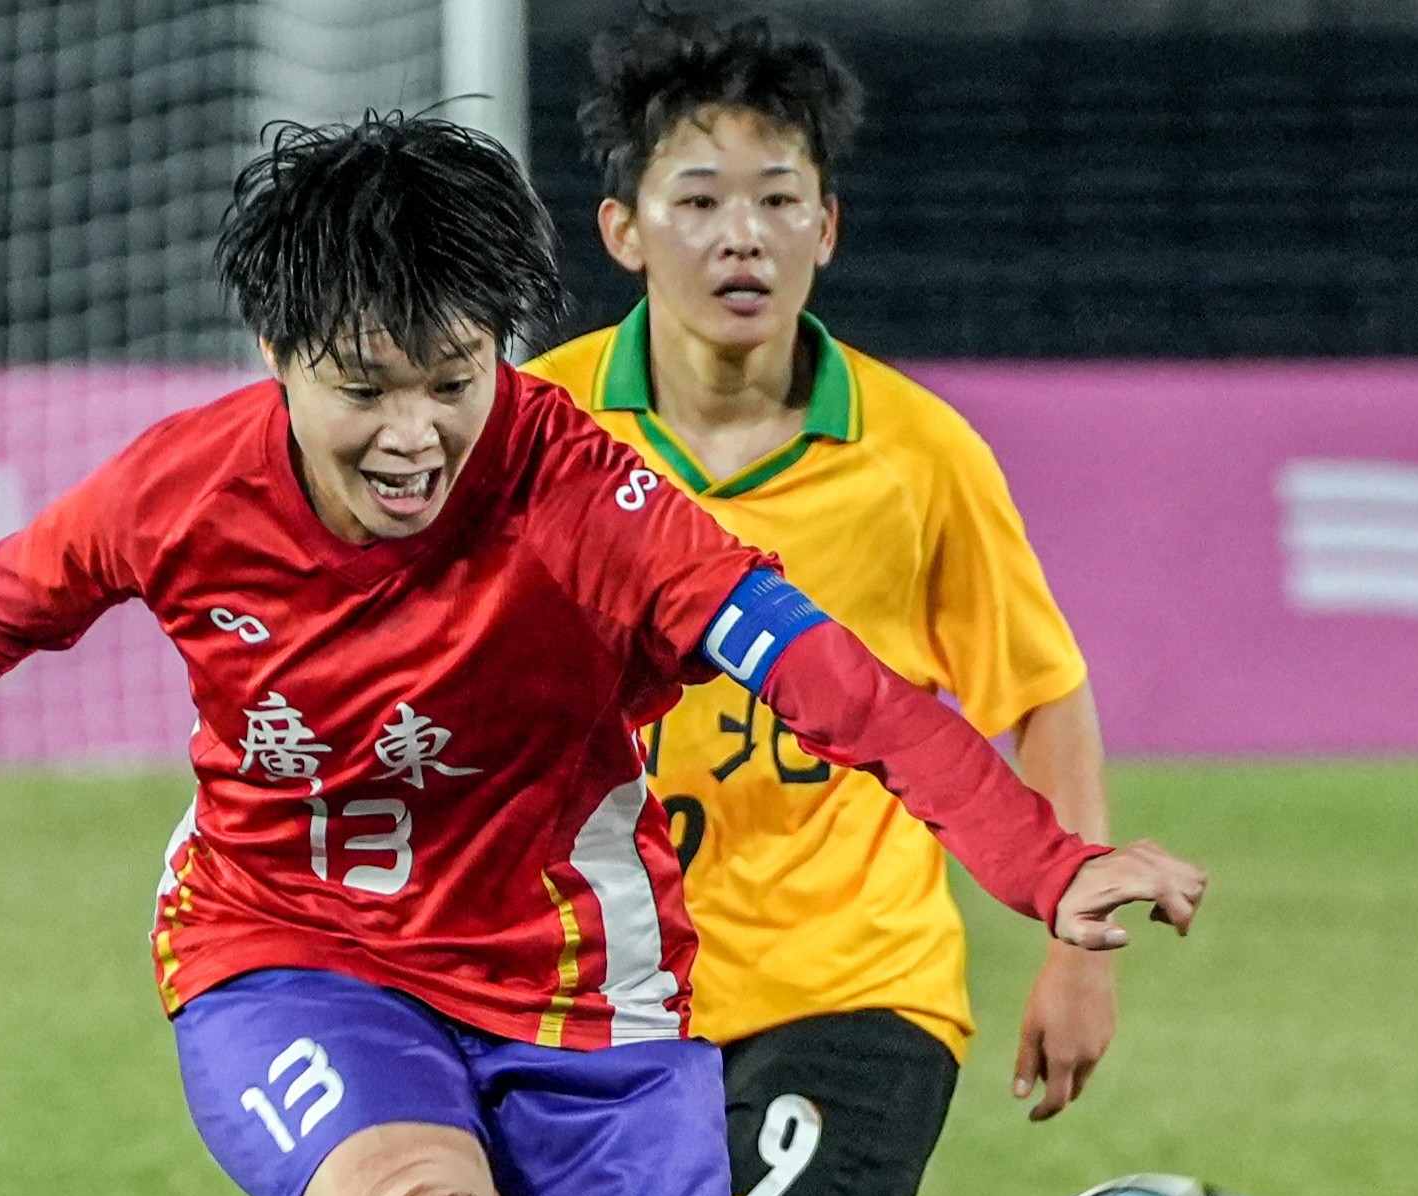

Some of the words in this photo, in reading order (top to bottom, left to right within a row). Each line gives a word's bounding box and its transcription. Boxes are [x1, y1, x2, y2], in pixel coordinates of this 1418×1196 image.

[237, 690, 484, 796] 廣東
[303, 797, 414, 895] 13
[239, 1036, 345, 1154] 13
